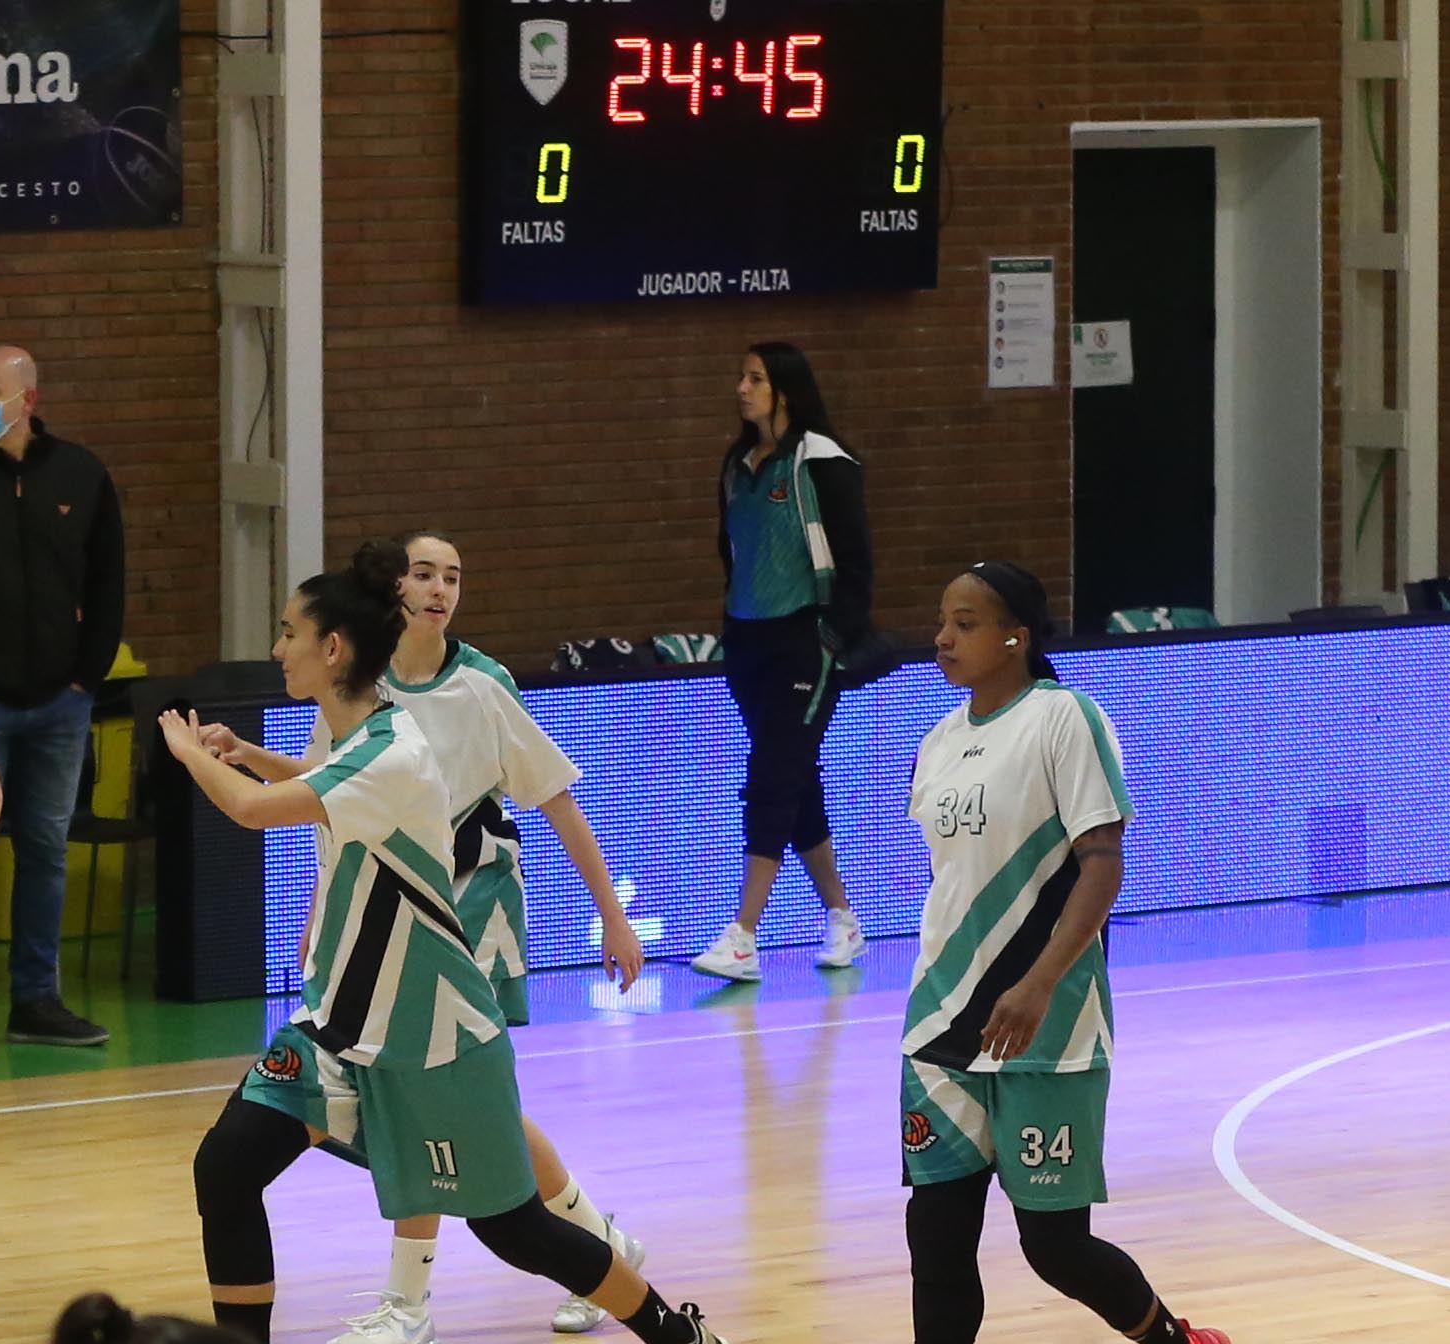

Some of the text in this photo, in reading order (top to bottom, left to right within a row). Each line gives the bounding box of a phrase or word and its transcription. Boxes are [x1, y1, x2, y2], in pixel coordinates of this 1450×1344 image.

[607, 35, 824, 122] 24:45
[535, 142, 571, 203] 0
[893, 134, 925, 193] 0
[502, 220, 566, 245] FALTAS
[860, 209, 918, 233] FALTAS
[637, 271, 722, 296] JUGADOR
[740, 269, 791, 292] FALTA
[935, 783, 987, 839] 34
[423, 1138, 458, 1178] 11
[1020, 1123, 1075, 1168] 34
